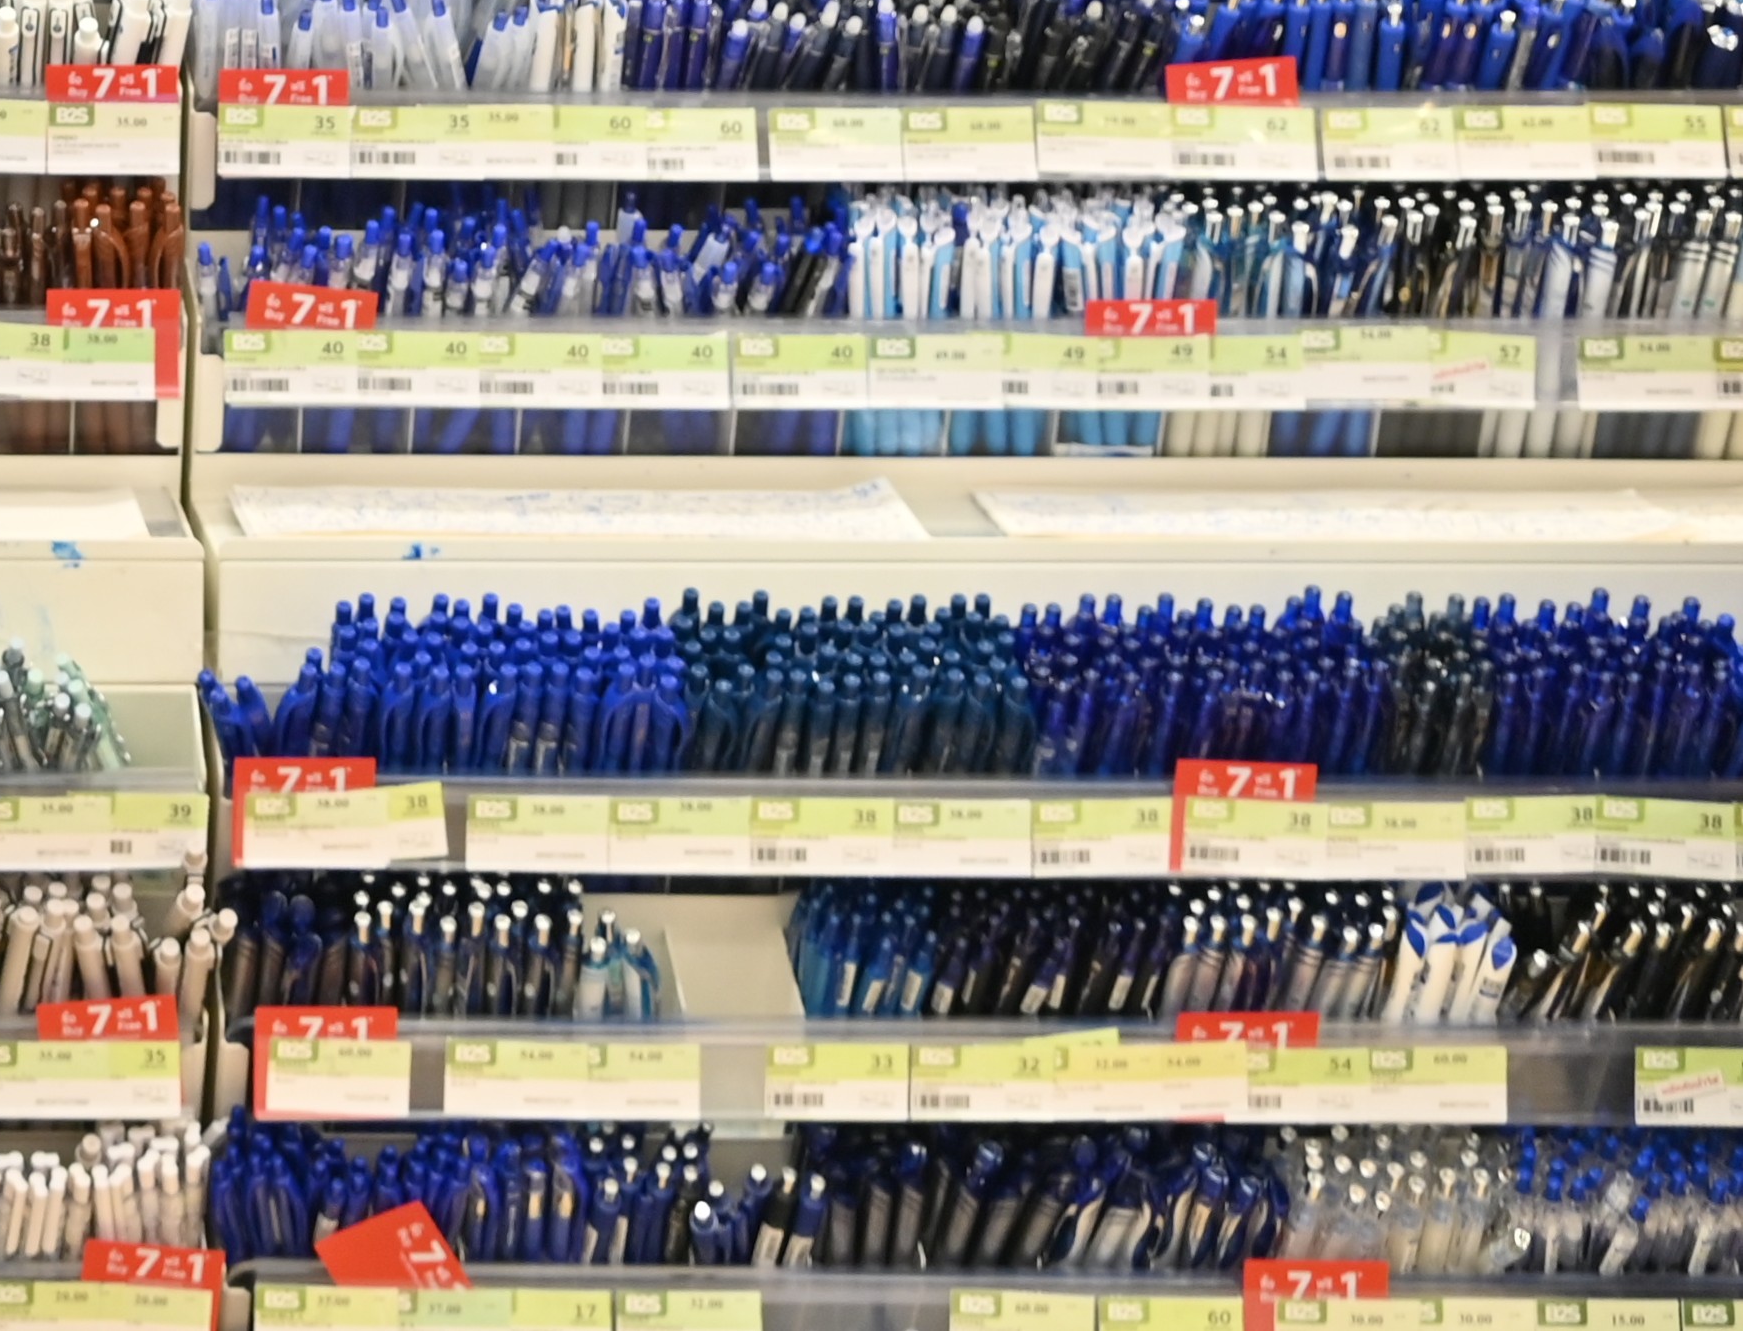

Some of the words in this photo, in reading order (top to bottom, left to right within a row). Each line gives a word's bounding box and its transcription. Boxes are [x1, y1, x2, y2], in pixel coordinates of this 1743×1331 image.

[92, 68, 116, 98] 7
[141, 68, 158, 98] 1
[1210, 66, 1234, 101] 7
[1259, 63, 1277, 96] 1
[55, 106, 89, 125] B2S
[117, 116, 148, 128] 35.00
[314, 115, 336, 135] 35
[29, 332, 51, 352] 38
[169, 803, 192, 822] 39
